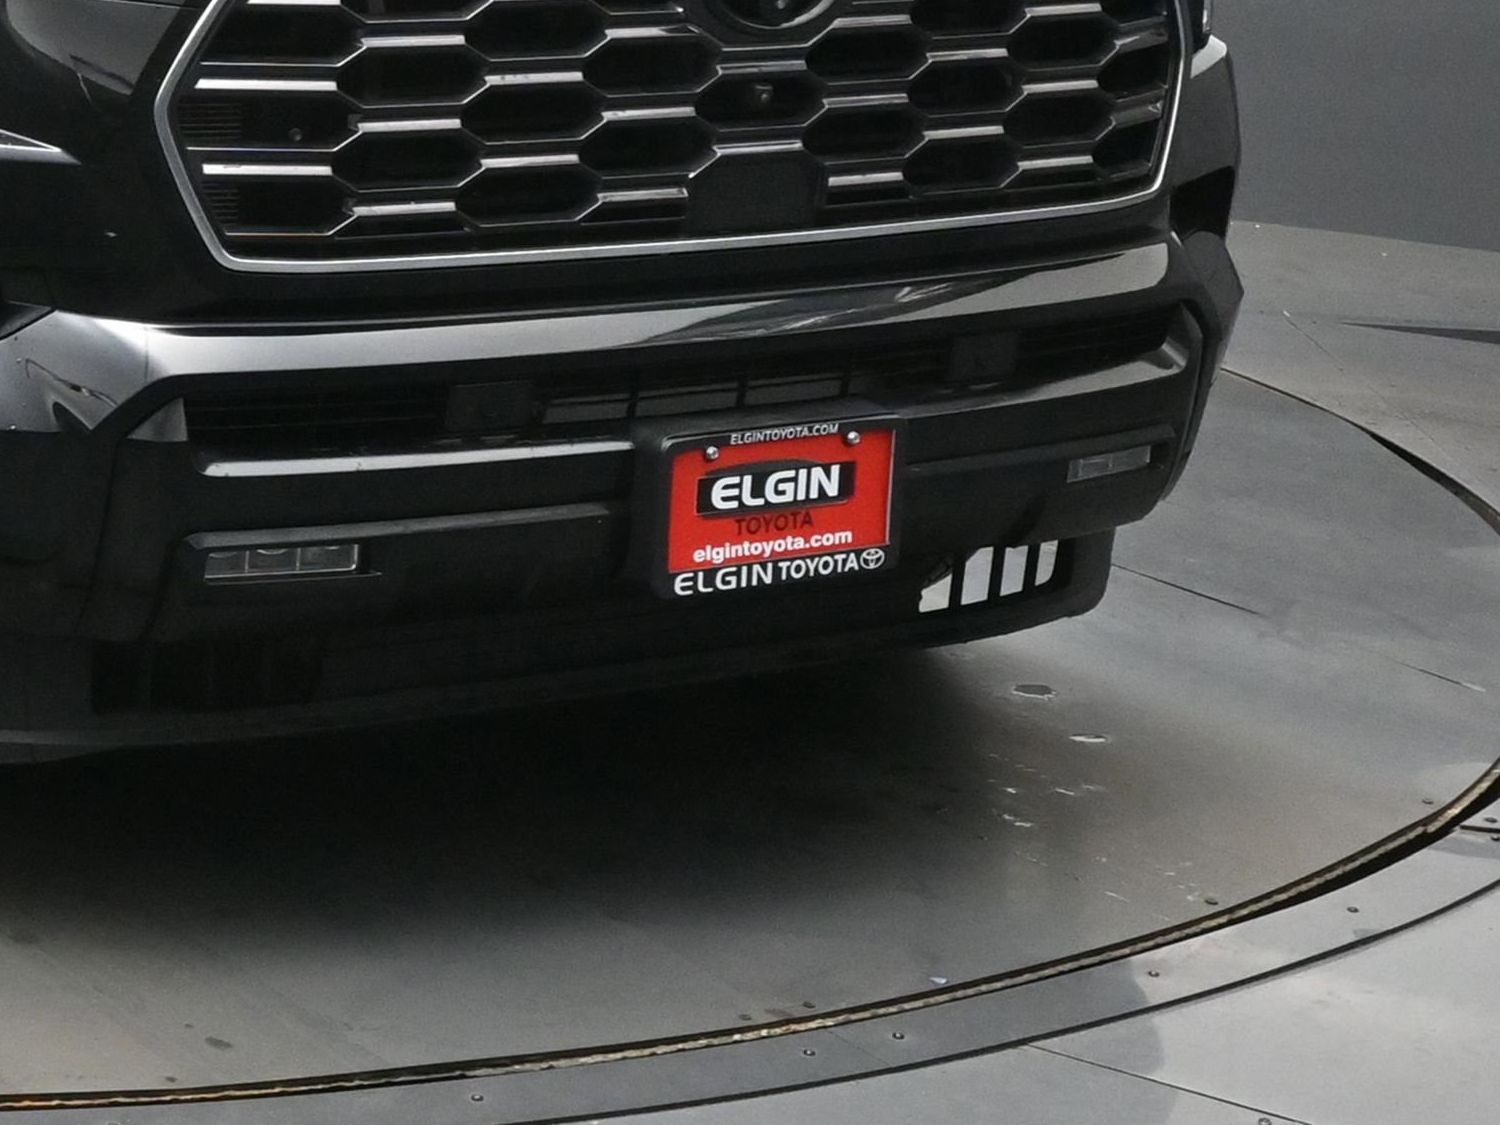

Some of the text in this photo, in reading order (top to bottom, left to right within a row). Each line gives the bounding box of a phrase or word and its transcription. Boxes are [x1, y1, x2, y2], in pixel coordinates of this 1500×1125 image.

[730, 423, 839, 445] ELGINTOYOTA.COM
[710, 463, 841, 510] ELGIN
[734, 510, 814, 536] TOYOTA
[692, 530, 853, 564] elgintoyota.com
[673, 553, 859, 596] ELGIN TOYOTA
